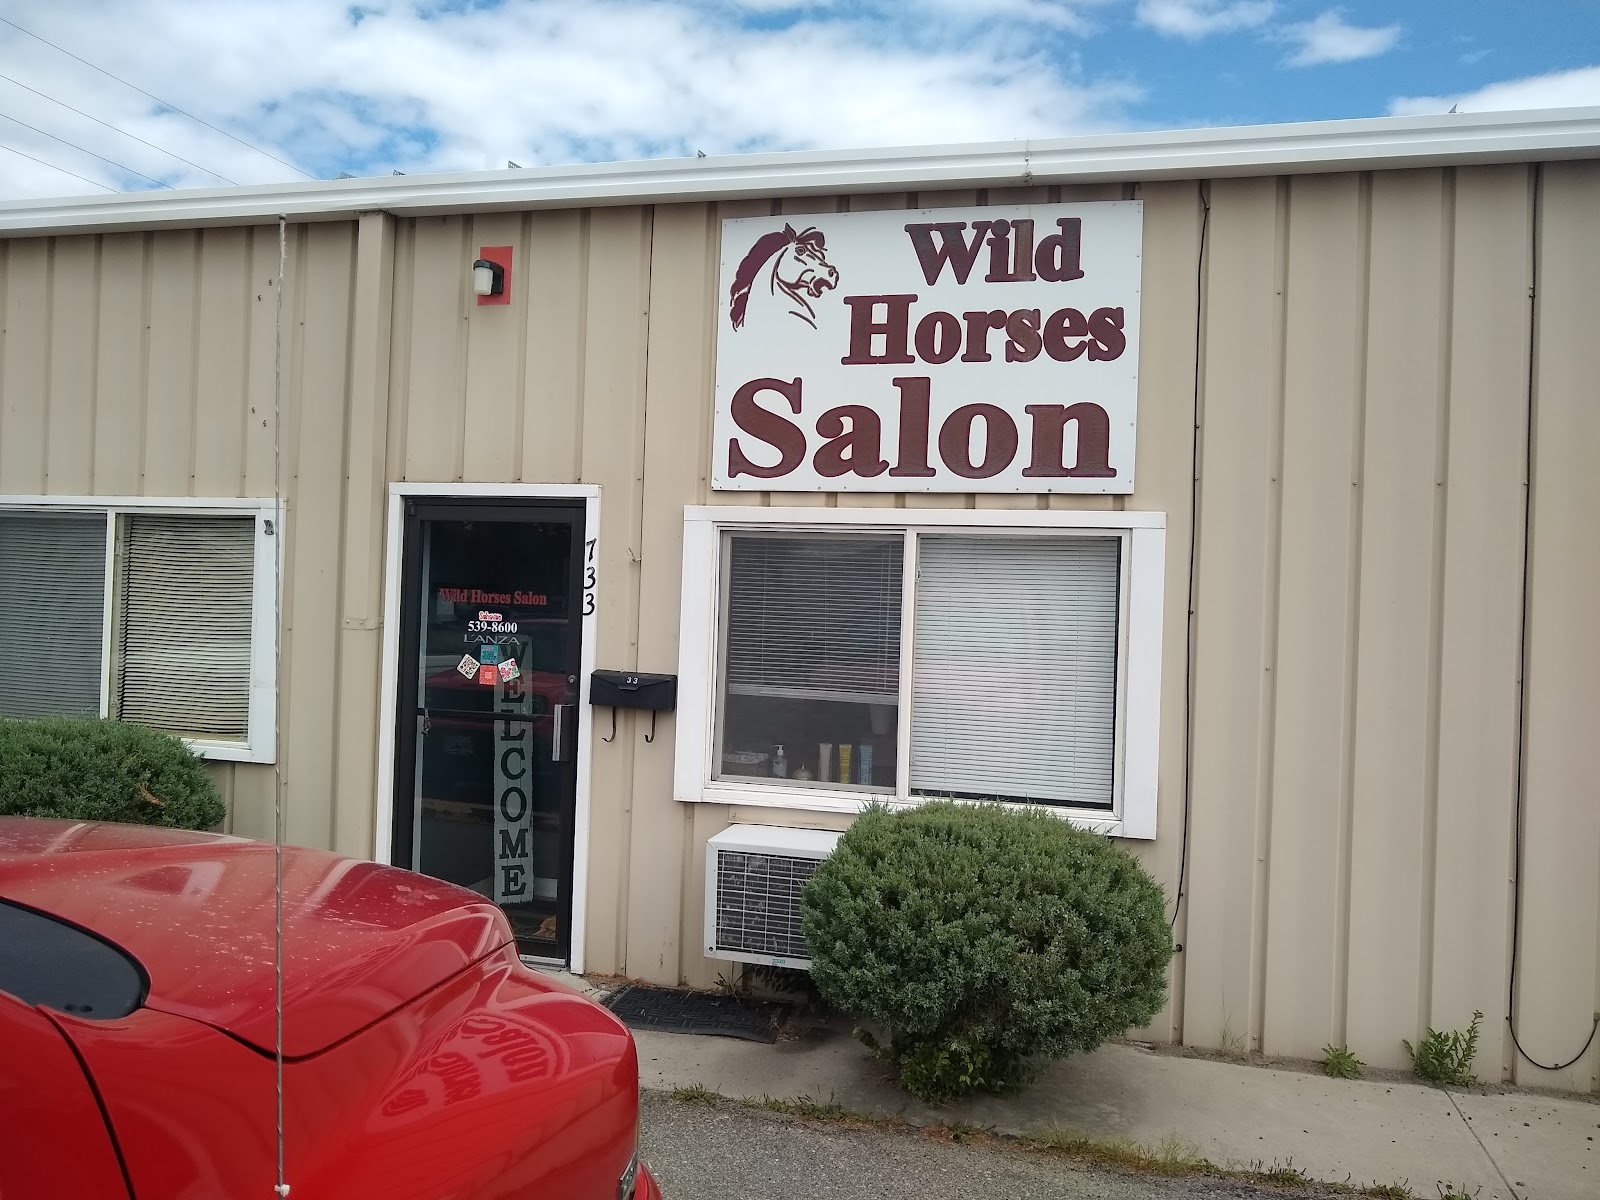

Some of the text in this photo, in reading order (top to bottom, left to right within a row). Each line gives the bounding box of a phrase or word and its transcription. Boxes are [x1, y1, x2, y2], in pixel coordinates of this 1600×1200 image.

[904, 217, 1085, 286] Wild
[841, 294, 1127, 365] Horses
[727, 376, 1118, 479] Salon
[439, 588, 547, 605] Wild Horses Salon
[582, 538, 598, 616] 733
[467, 620, 518, 633] 539-8600
[626, 676, 639, 685] 33
[499, 641, 529, 897] WELCOME
